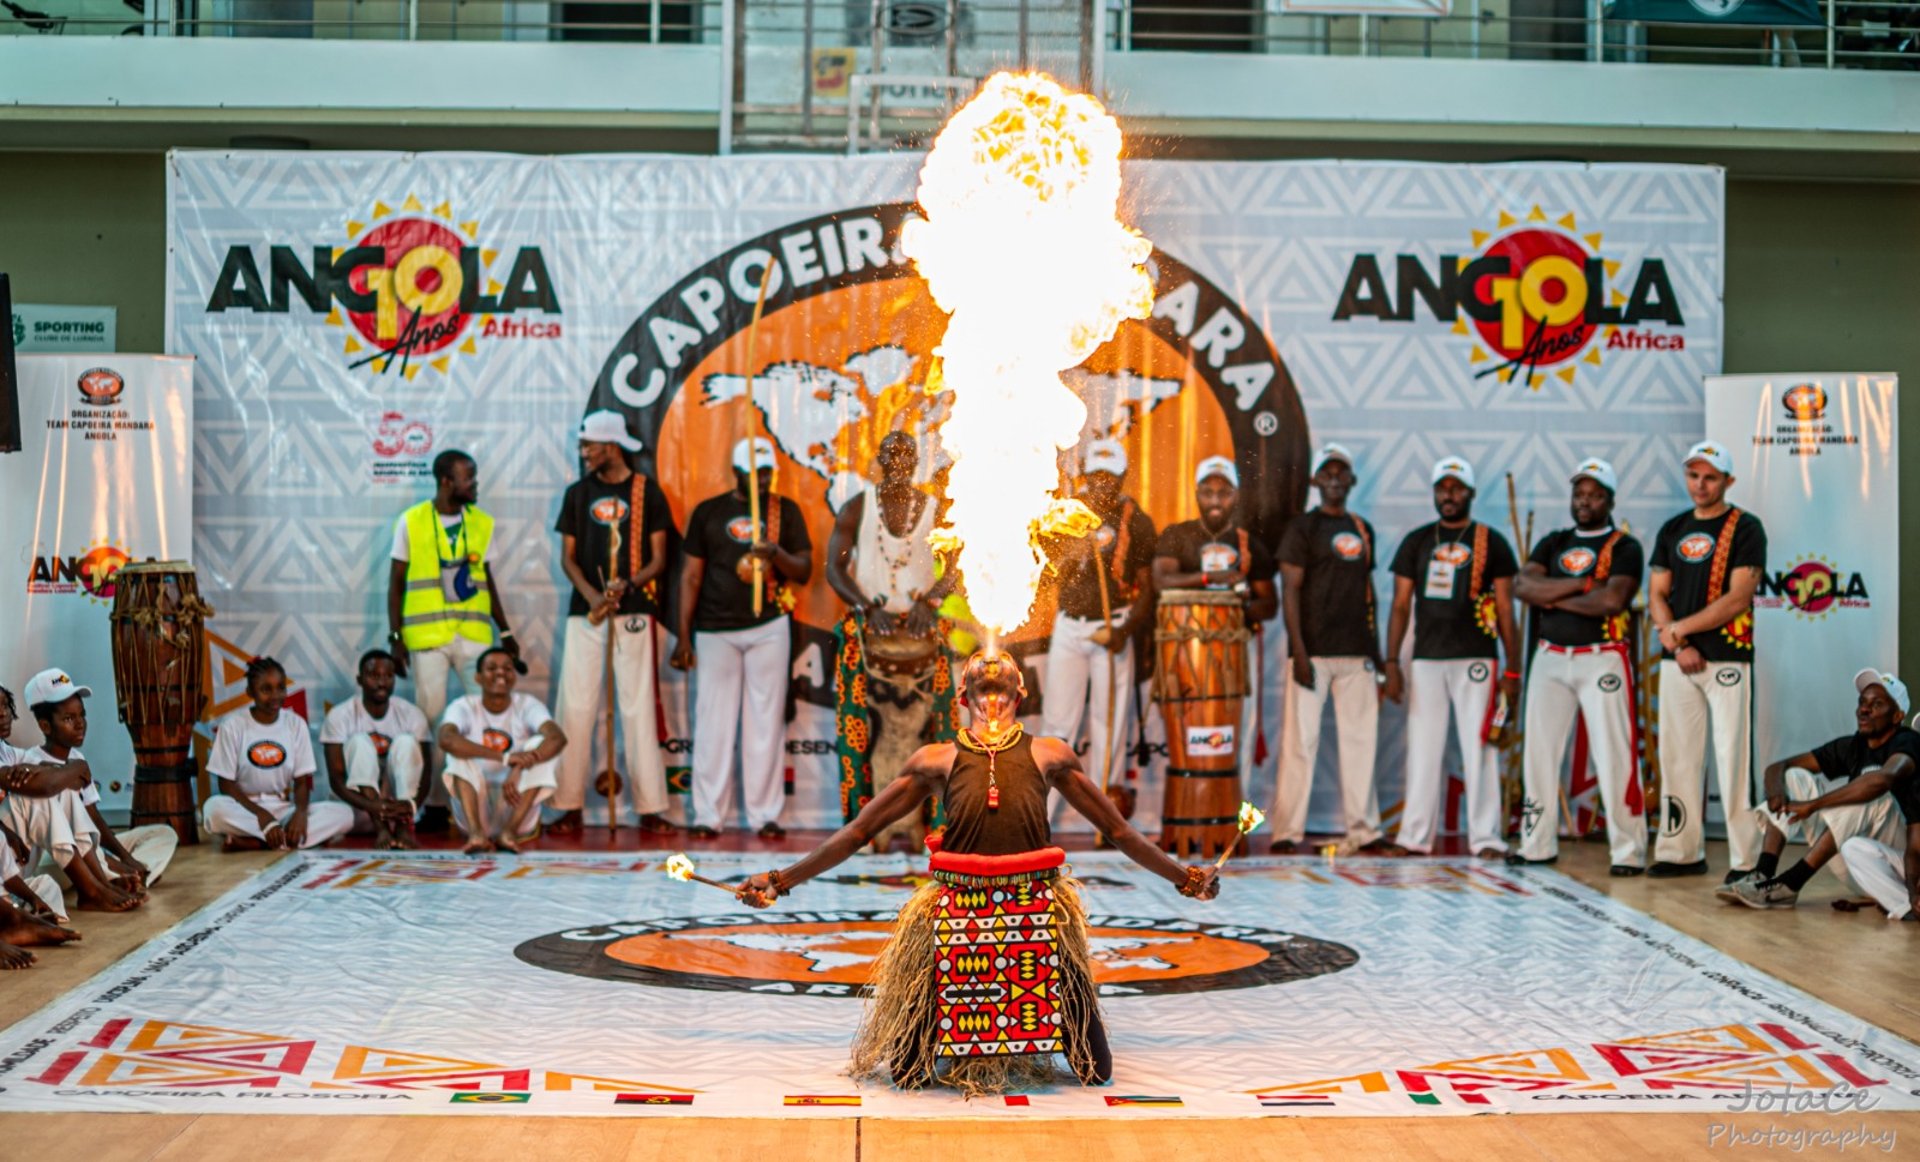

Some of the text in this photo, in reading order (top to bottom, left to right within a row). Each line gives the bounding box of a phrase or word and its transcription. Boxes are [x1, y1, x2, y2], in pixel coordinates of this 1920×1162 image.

[34, 321, 105, 333] SPORTING
[482, 318, 561, 338] Africa
[349, 305, 459, 376] Anos
[1607, 329, 1684, 350] Africa
[1475, 316, 1584, 386] Anos
[46, 420, 154, 430] TEAM CAPOEIRA MANDARA
[85, 432, 117, 440] ANGOLA
[1755, 572, 1868, 599] NGOLA
[53, 1089, 414, 1100] CAPOEIRA FILOSOFIA
[1532, 1093, 1701, 1101] CAPOEIRA
